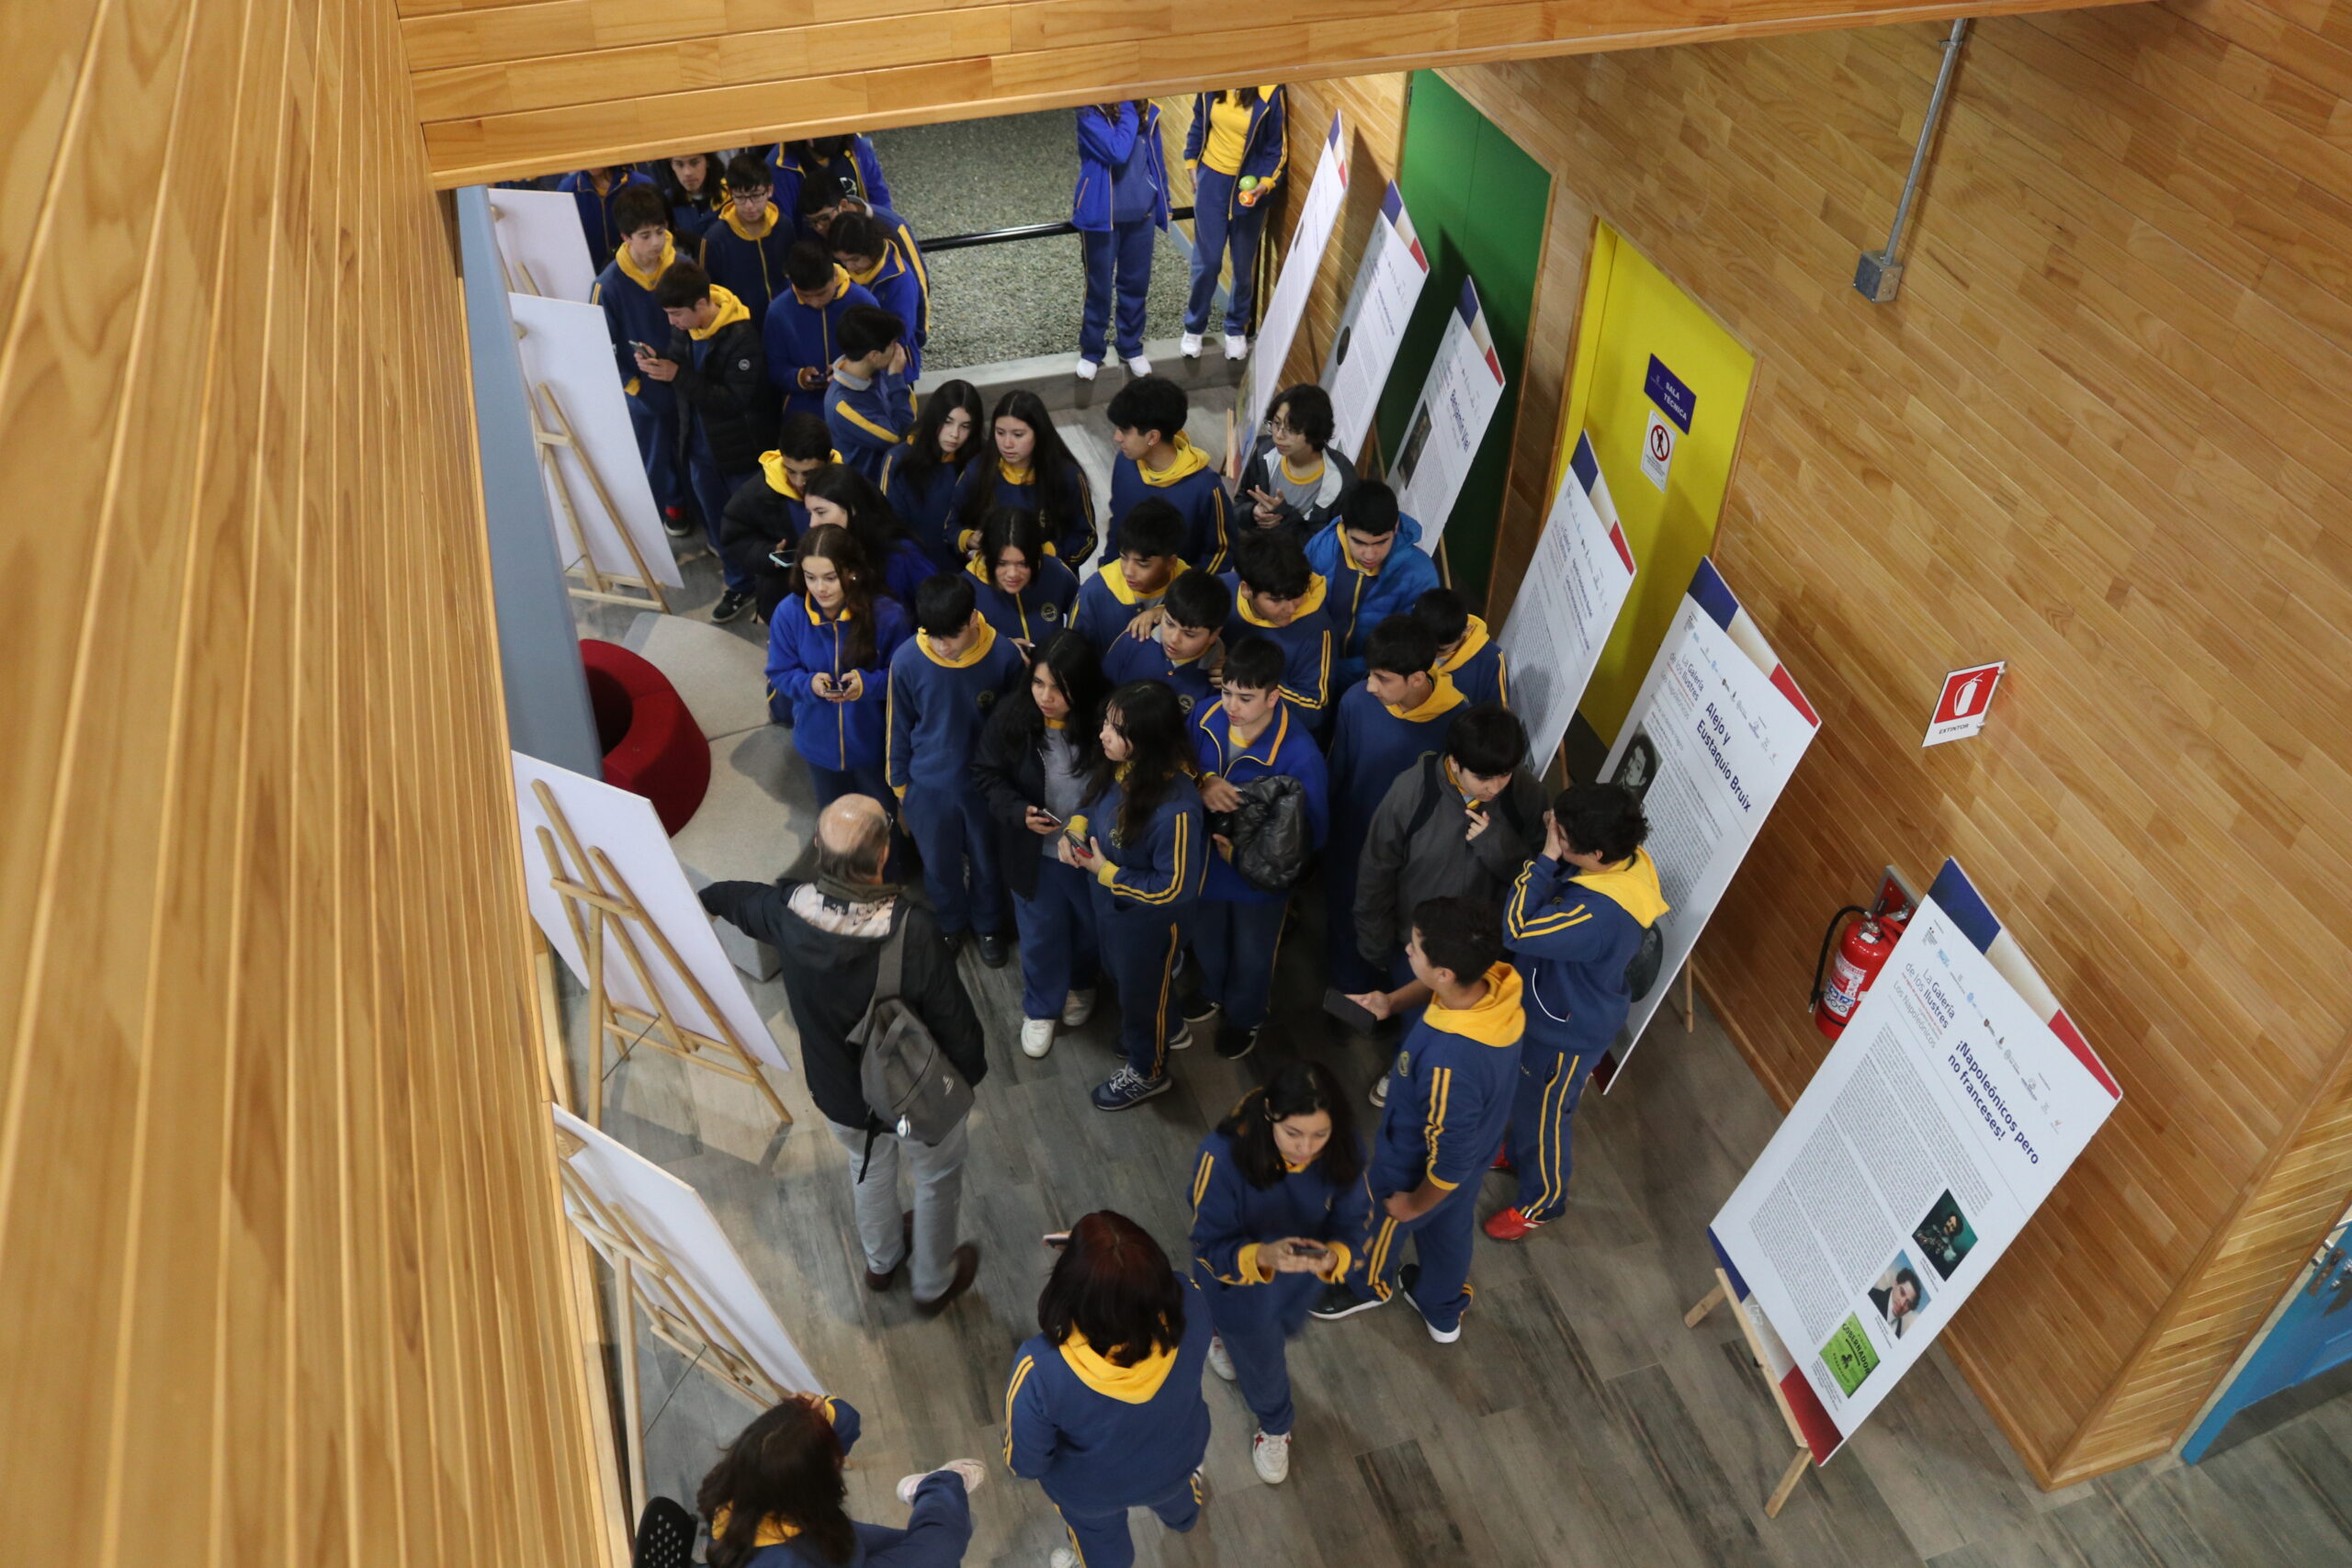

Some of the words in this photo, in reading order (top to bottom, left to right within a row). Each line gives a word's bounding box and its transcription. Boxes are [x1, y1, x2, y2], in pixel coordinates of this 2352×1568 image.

[1664, 392, 1687, 421] TÉCNICA
[1666, 381, 1679, 400] SALA
[1688, 663, 1704, 692] Galería
[1705, 702, 1726, 738] Alejo
[1723, 733, 1731, 746] y
[1939, 723, 1970, 734] EXTINTOR
[1697, 720, 1731, 780] Eustaquio
[1730, 775, 1751, 813] Bruix
[1893, 980, 1904, 998] Los
[1902, 994, 1937, 1048] Napoleónicos
[1905, 963, 1916, 977] de
[1913, 971, 1926, 992] los
[1923, 987, 1949, 1029] Ilustres
[1923, 968, 1933, 985] La
[1931, 982, 1956, 1019] Galería
[1948, 1055, 1961, 1073] no
[1960, 1070, 2007, 1141] franceses!
[1955, 1040, 2018, 1132] ¡Napoleónicos
[2014, 1131, 2039, 1165] pero
